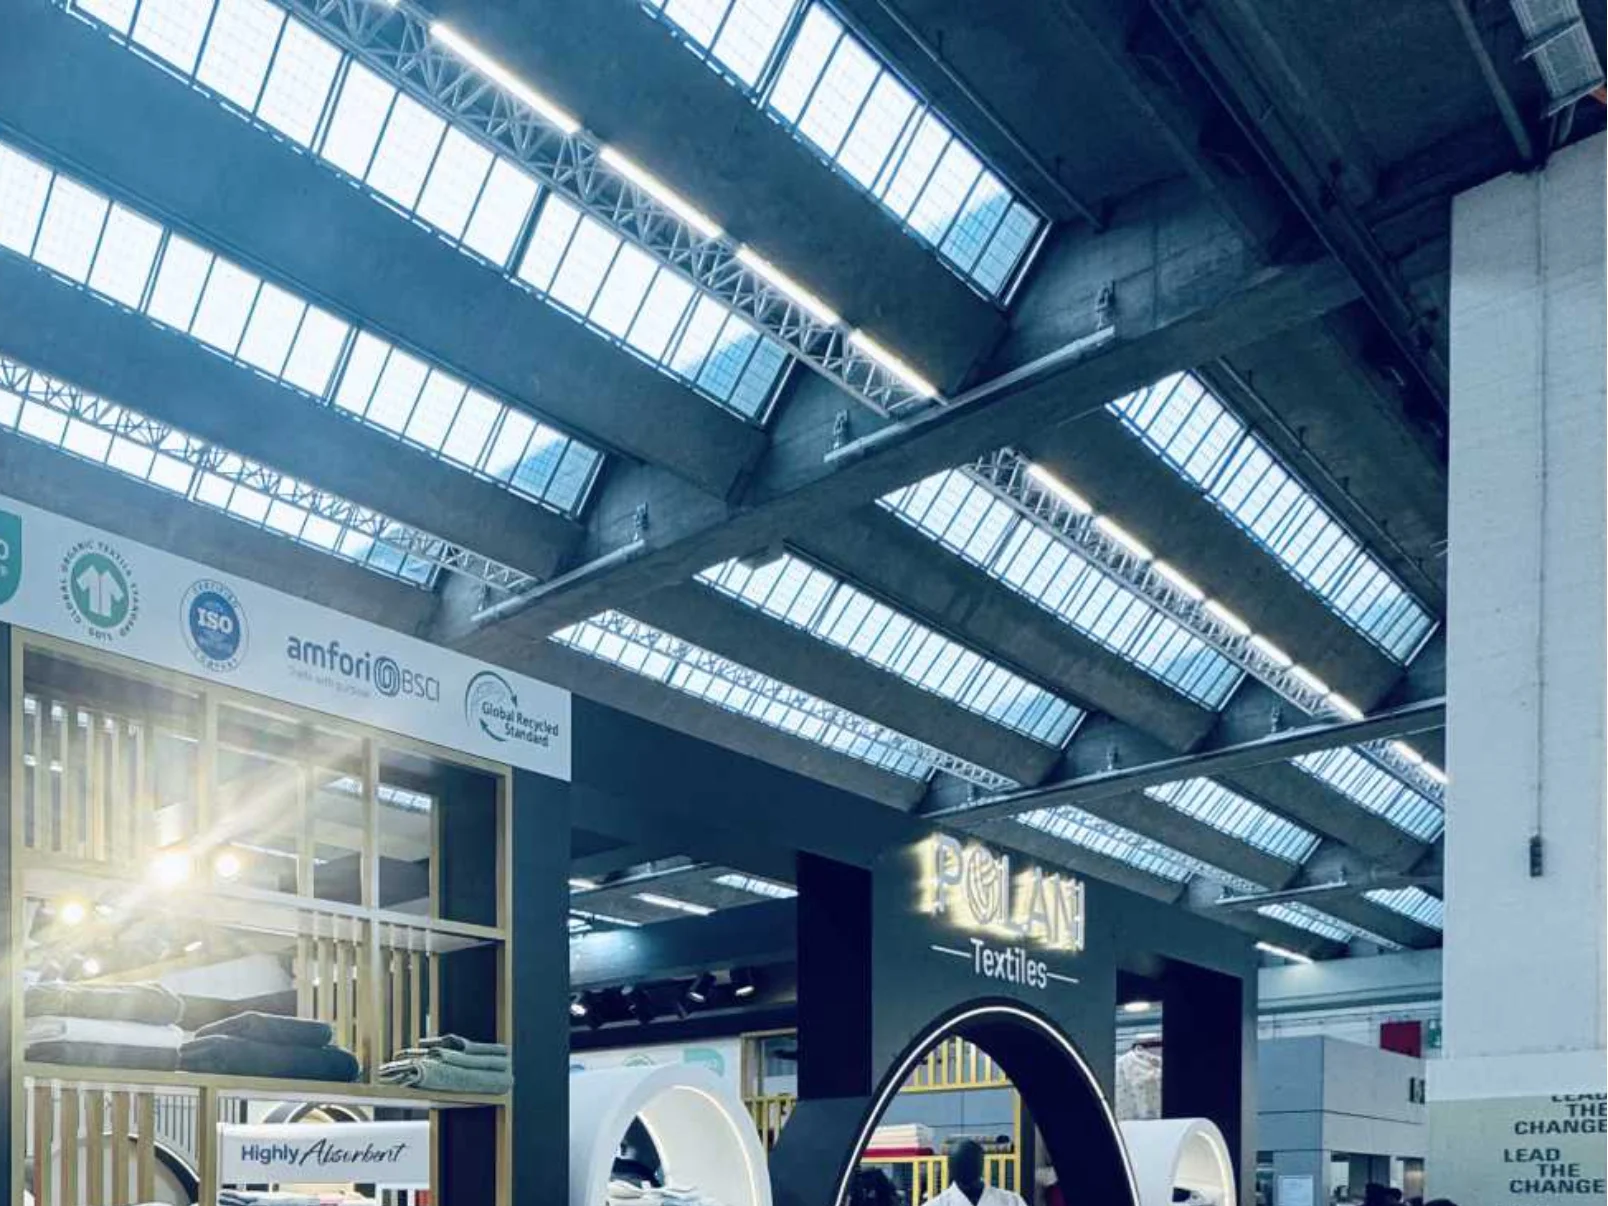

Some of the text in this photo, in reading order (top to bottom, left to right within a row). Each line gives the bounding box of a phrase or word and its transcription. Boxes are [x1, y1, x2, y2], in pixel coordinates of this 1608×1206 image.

[197, 607, 234, 635] ISO
[287, 635, 371, 682] amfori
[401, 669, 441, 702] BSCI
[481, 701, 559, 737] Global Recycled
[504, 722, 549, 748] Standard
[933, 832, 1086, 952] POLANI
[970, 937, 1048, 989] Textiles
[1566, 1103, 1607, 1118] THE
[1514, 1119, 1607, 1135] CHANGE
[242, 1138, 406, 1166] Highly Absorbent
[1503, 1148, 1561, 1163] LEAD
[1536, 1163, 1581, 1178] THE
[1509, 1179, 1606, 1194] CHANGE
